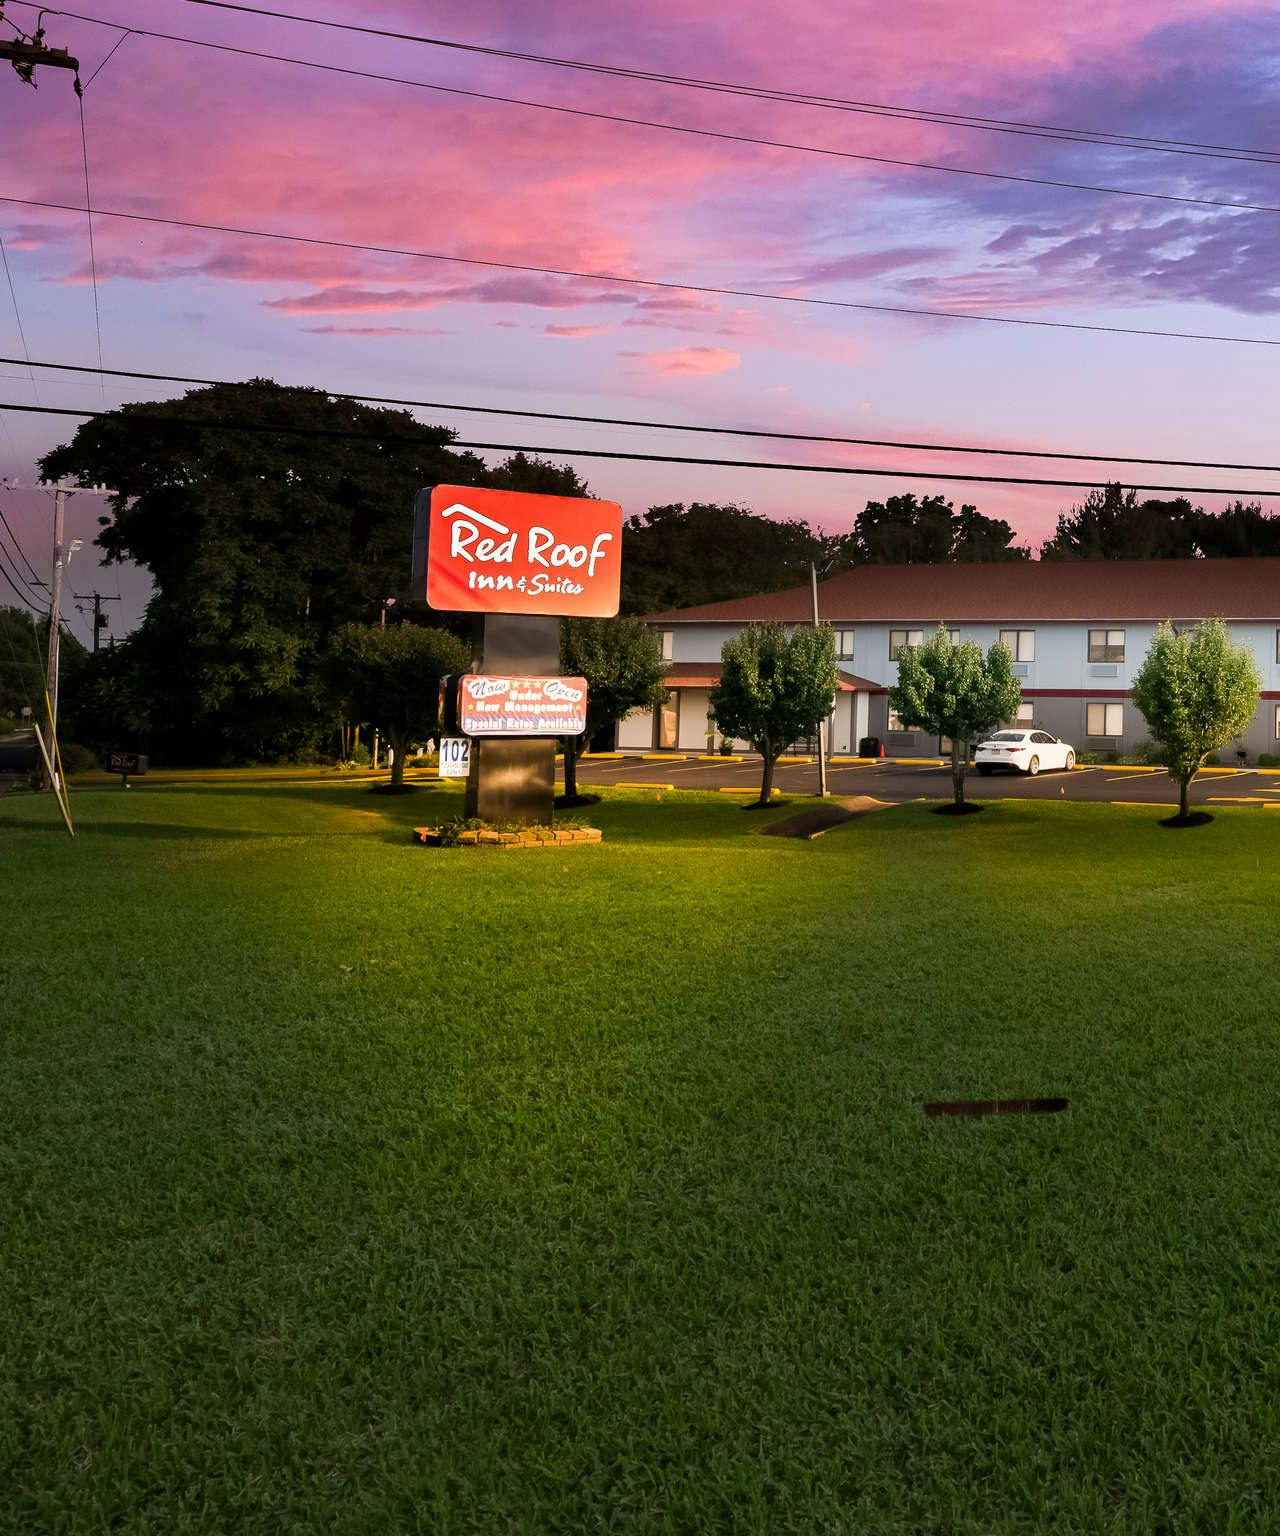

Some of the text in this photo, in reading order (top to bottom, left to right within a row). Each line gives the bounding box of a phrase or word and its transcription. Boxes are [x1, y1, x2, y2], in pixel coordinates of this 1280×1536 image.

[451, 519, 613, 577] Red Roof
[468, 571, 584, 596] Inn & Suites
[471, 680, 506, 696] Now
[509, 690, 542, 700] Under
[545, 682, 580, 699] Open
[476, 701, 573, 714] New Management
[464, 718, 502, 731] Special
[538, 719, 583, 729] Available
[442, 740, 469, 762] 102
